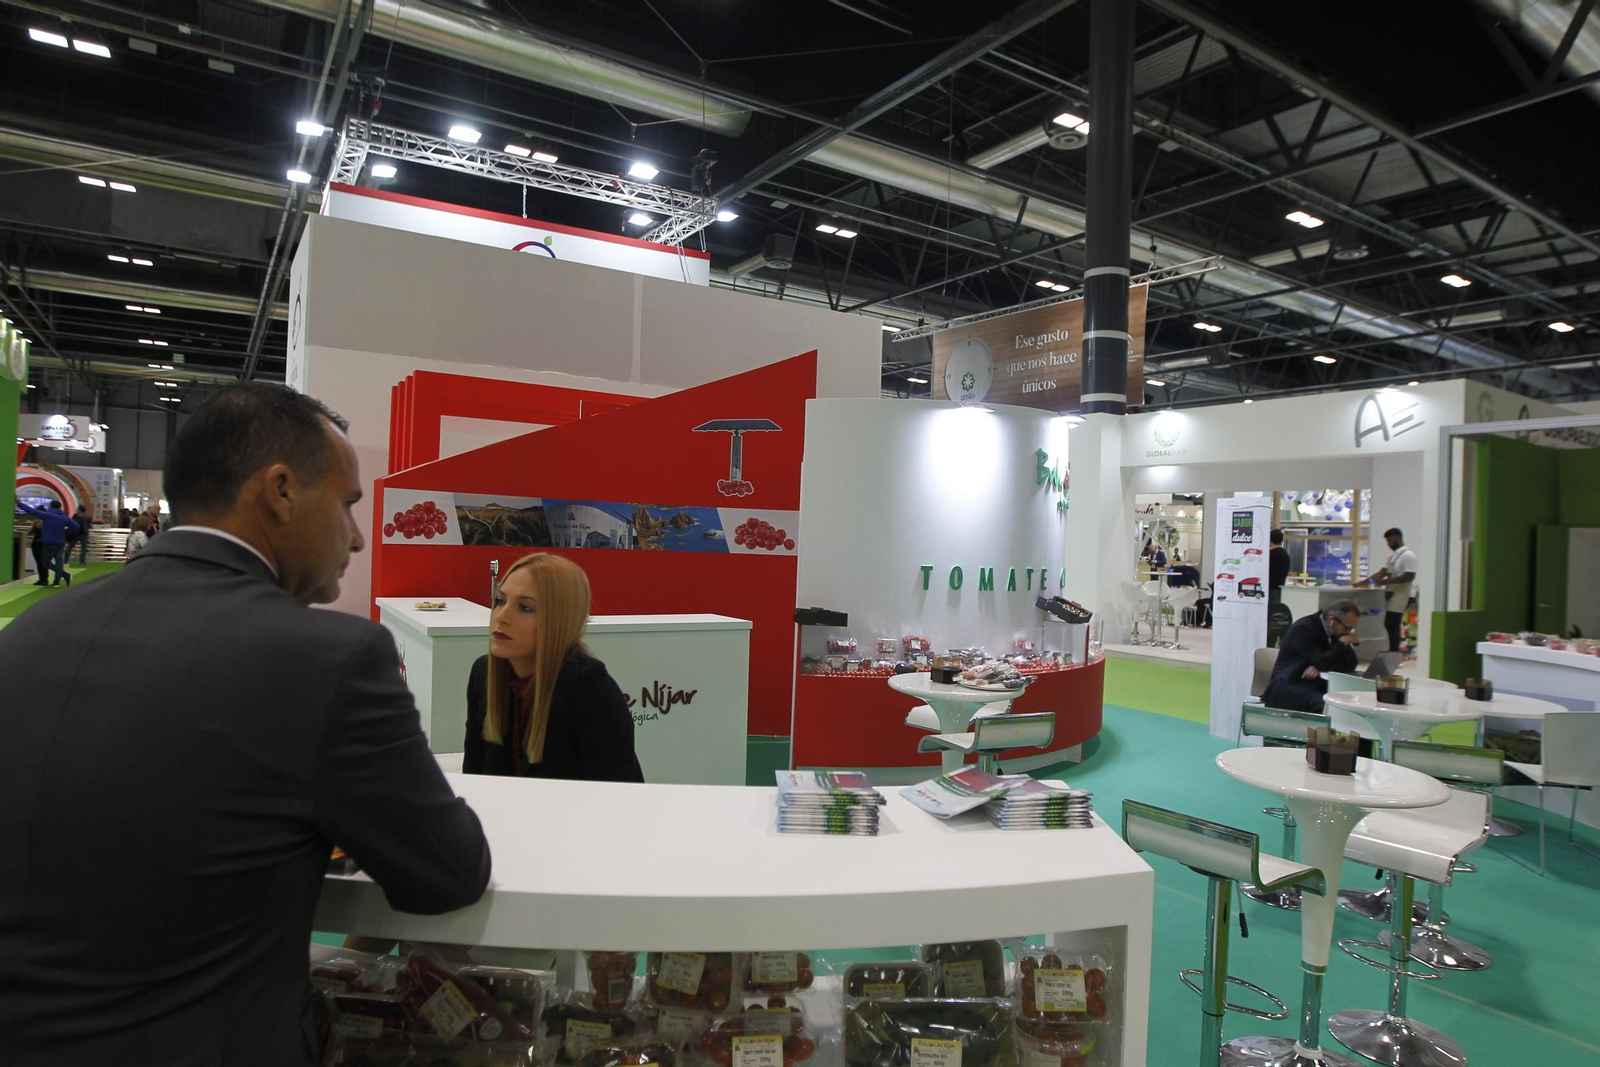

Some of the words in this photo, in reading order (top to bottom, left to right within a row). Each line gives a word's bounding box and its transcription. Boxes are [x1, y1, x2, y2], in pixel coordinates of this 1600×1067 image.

[1015, 334, 1035, 349] Ese
[1036, 329, 1069, 349] gusto
[1006, 361, 1026, 377] que
[1028, 356, 1047, 370] nos
[1049, 351, 1077, 366] hace
[1022, 378, 1057, 393] únicos
[641, 680, 698, 715] Níjar
[630, 710, 659, 726] lógica
